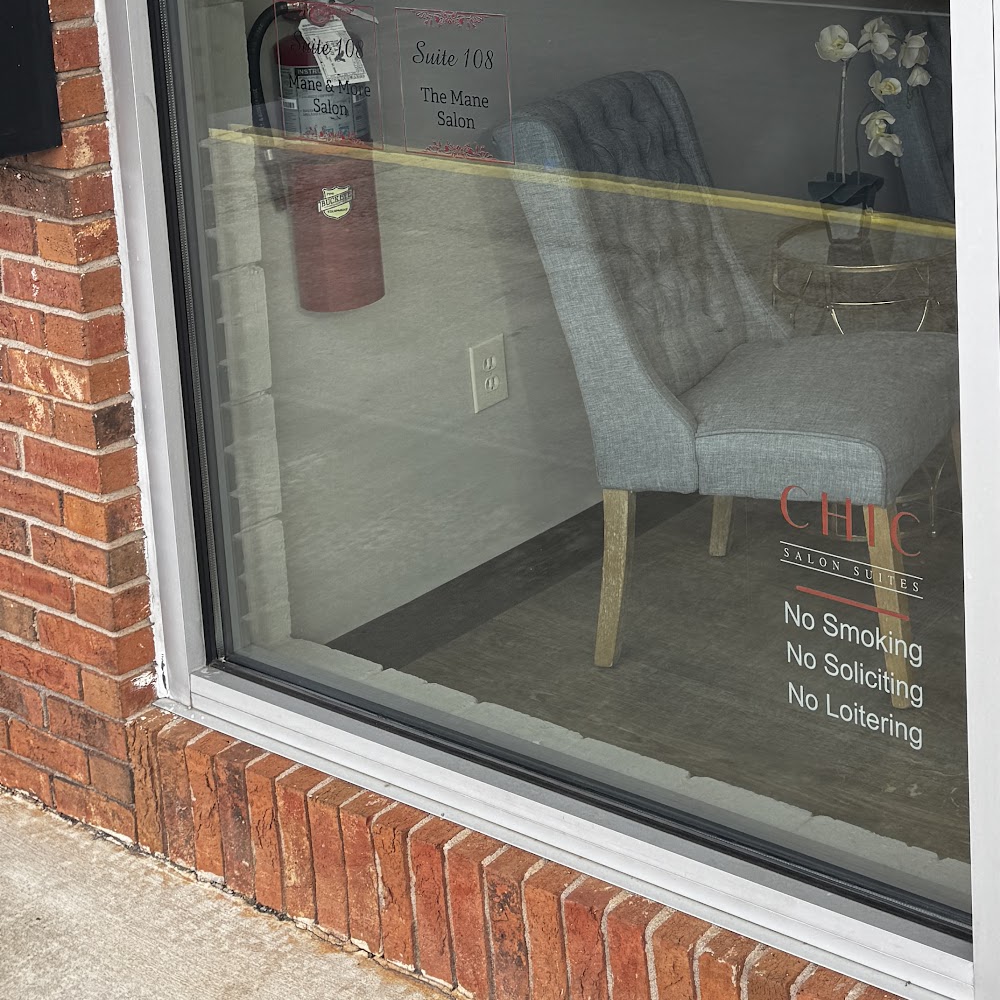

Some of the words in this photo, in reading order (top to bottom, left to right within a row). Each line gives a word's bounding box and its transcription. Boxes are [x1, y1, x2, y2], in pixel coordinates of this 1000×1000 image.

[412, 40, 458, 67] Suite
[463, 48, 494, 69] 108
[289, 74, 322, 92] Mane
[325, 80, 335, 92] &
[338, 80, 371, 97] More
[420, 87, 447, 104] The
[450, 89, 489, 108] Mane
[313, 98, 348, 116] Salon
[437, 110, 476, 129] Salon
[780, 485, 921, 557] CHIC
[784, 547, 840, 571] SALON
[853, 566, 920, 592] SUITES
[784, 601, 815, 631] No
[822, 612, 923, 668] Smoking
[787, 640, 816, 670] No
[824, 652, 923, 708] Soliciting
[788, 681, 819, 711] No
[826, 693, 923, 750] Loitering
